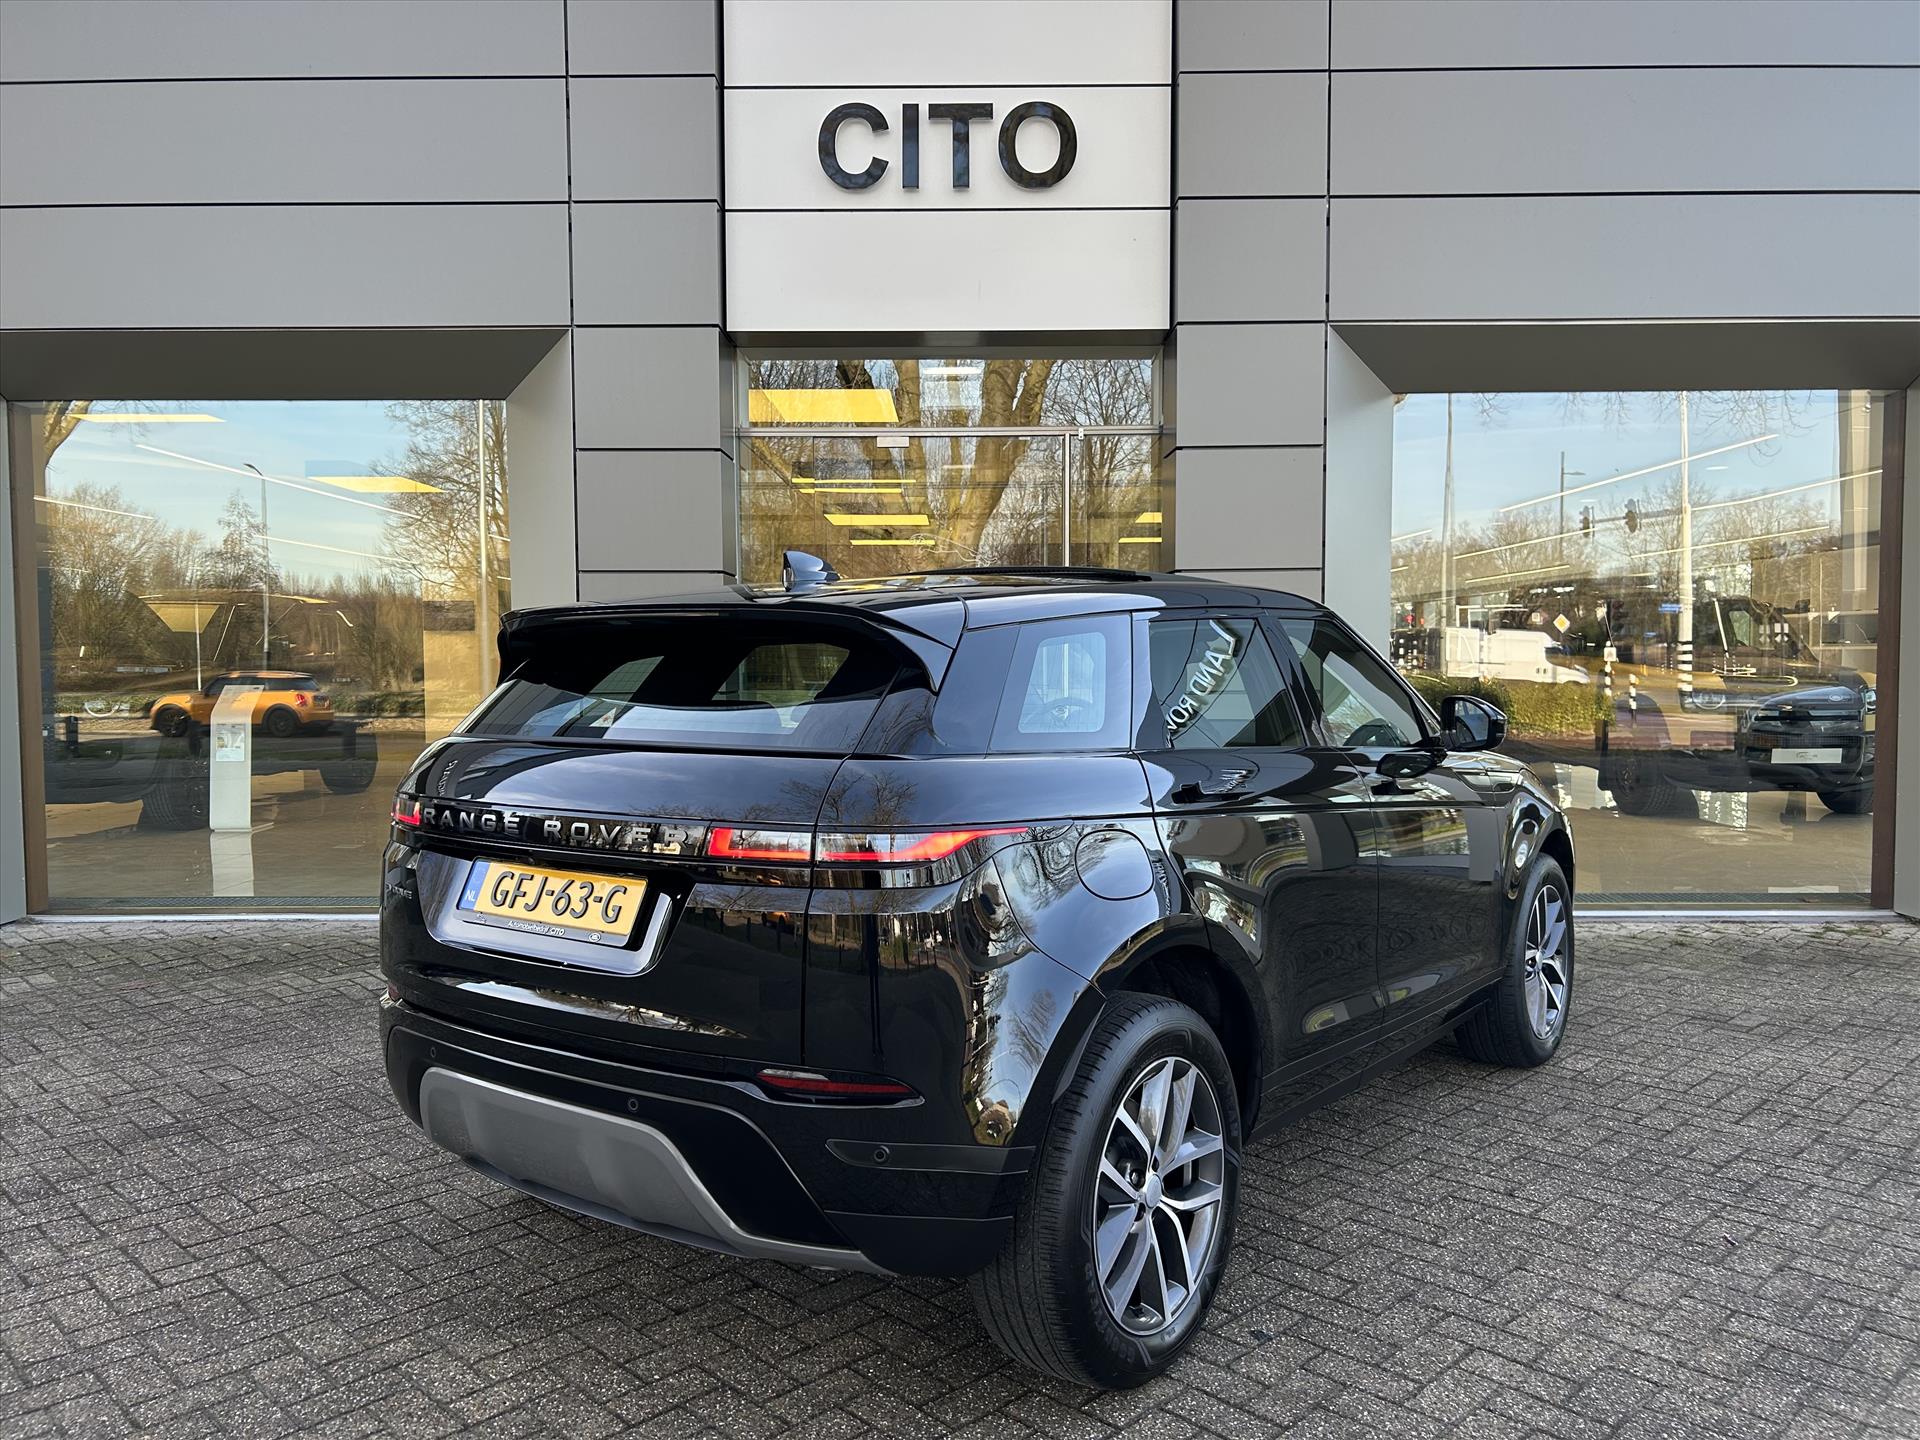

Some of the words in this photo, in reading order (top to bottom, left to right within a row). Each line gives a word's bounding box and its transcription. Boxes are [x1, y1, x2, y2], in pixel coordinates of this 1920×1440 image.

[818, 101, 1078, 190] CITO
[423, 807, 520, 835] RANGE
[543, 820, 689, 849] ROVER
[465, 890, 476, 903] NL
[490, 870, 628, 924] GFJ-63-G
